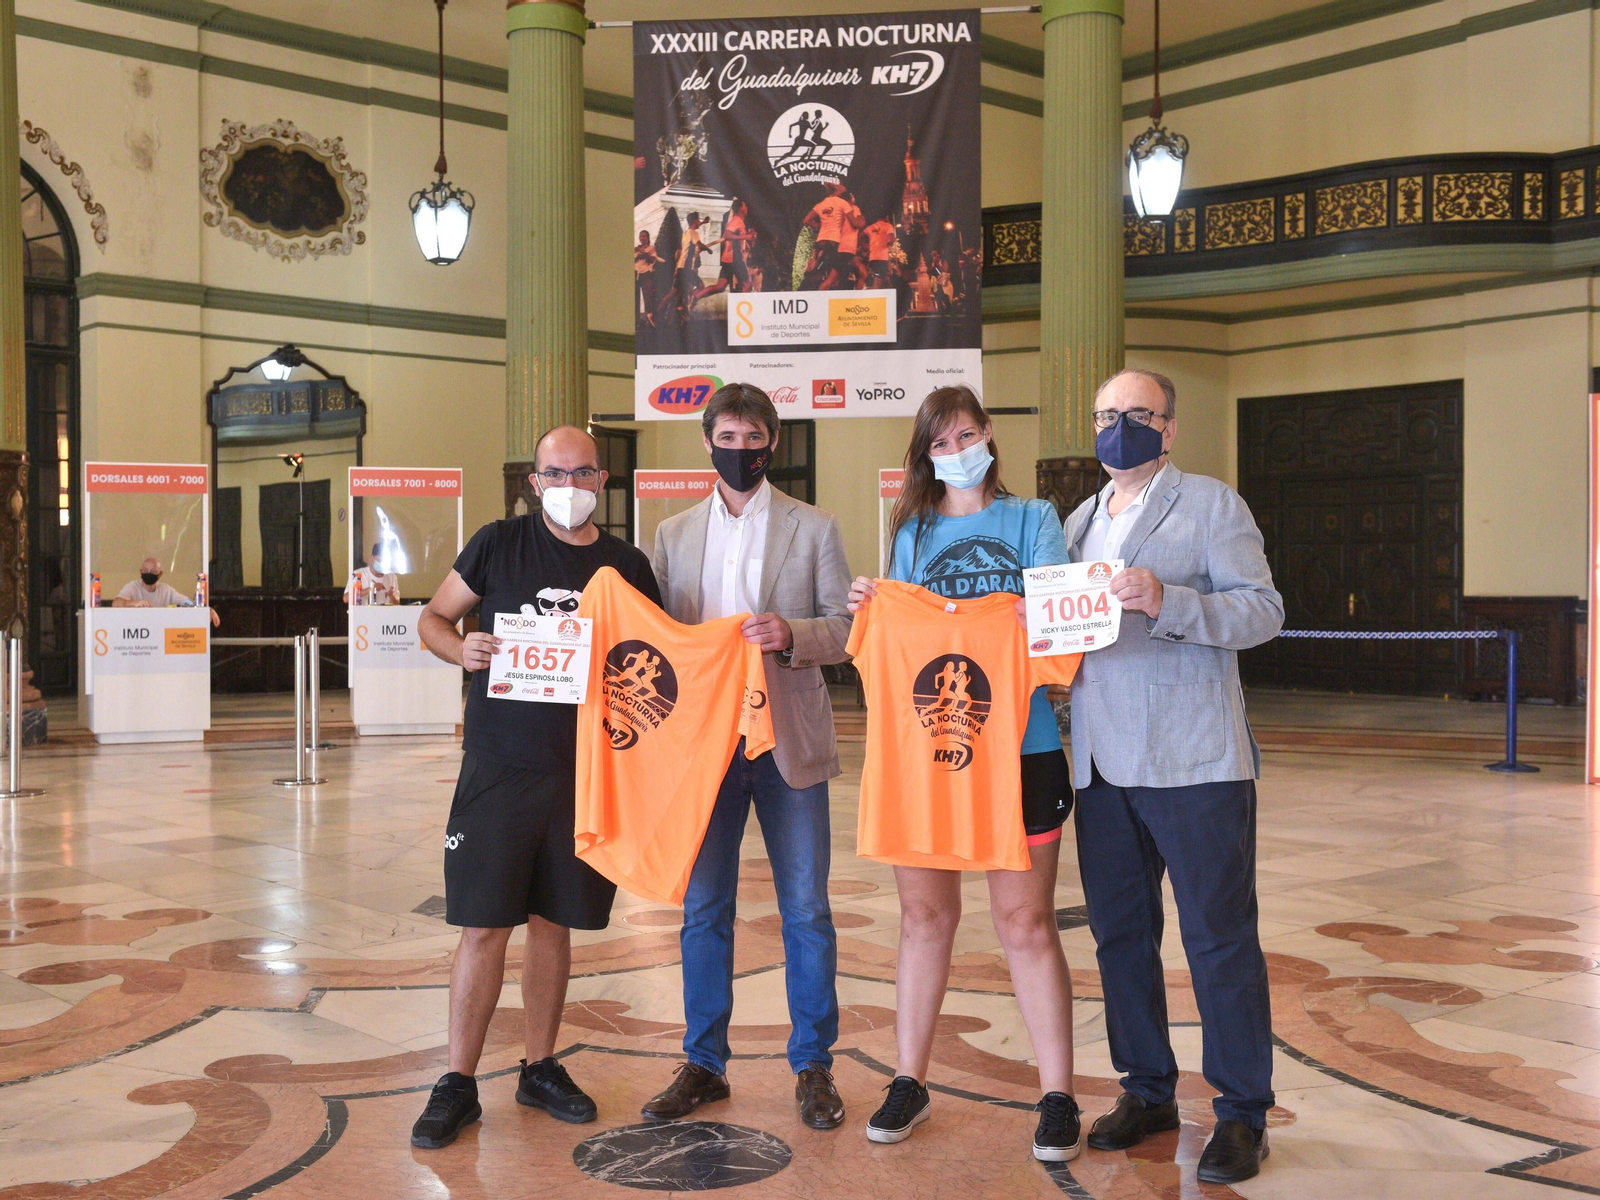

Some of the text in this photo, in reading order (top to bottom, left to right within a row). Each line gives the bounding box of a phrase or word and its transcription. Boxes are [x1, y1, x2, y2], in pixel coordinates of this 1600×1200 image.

[650, 22, 972, 54] XXXIII CARRERA NOCTURNA
[680, 67, 714, 91] del
[717, 53, 862, 111] Guadalquivir
[773, 161, 848, 179] LA NOCTURNA
[782, 172, 841, 187] del Guadalquivir
[772, 299, 809, 315] IMD
[760, 322, 821, 331] Instituto Municipal
[770, 331, 811, 339] de Deportes
[652, 362, 717, 371] Patrocinador principal:
[749, 362, 795, 370] Patrocinadores:
[946, 367, 966, 375] oficial:
[855, 387, 906, 401] YoPRO
[91, 473, 144, 484] DORSALES
[146, 475, 170, 484] 6001
[180, 475, 205, 485] 7000
[353, 478, 401, 488] DORSALES
[403, 479, 426, 488] 7001
[434, 479, 458, 488] 8000
[639, 481, 685, 490] DORSALES
[687, 481, 709, 490] 8001
[1042, 591, 1111, 622] 1004
[122, 628, 150, 639] IMD
[382, 625, 407, 635] IMD
[1041, 620, 1111, 634] VICKY VASCO ESTRELLA
[508, 645, 576, 672] 1657
[504, 672, 524, 680] JESÚS
[525, 674, 555, 682] ESPINOSA
[609, 700, 649, 733] Guadalquivir
[611, 691, 660, 729] NOCTURNA
[921, 713, 981, 735] LA NOCTURNA
[931, 729, 939, 737] del
